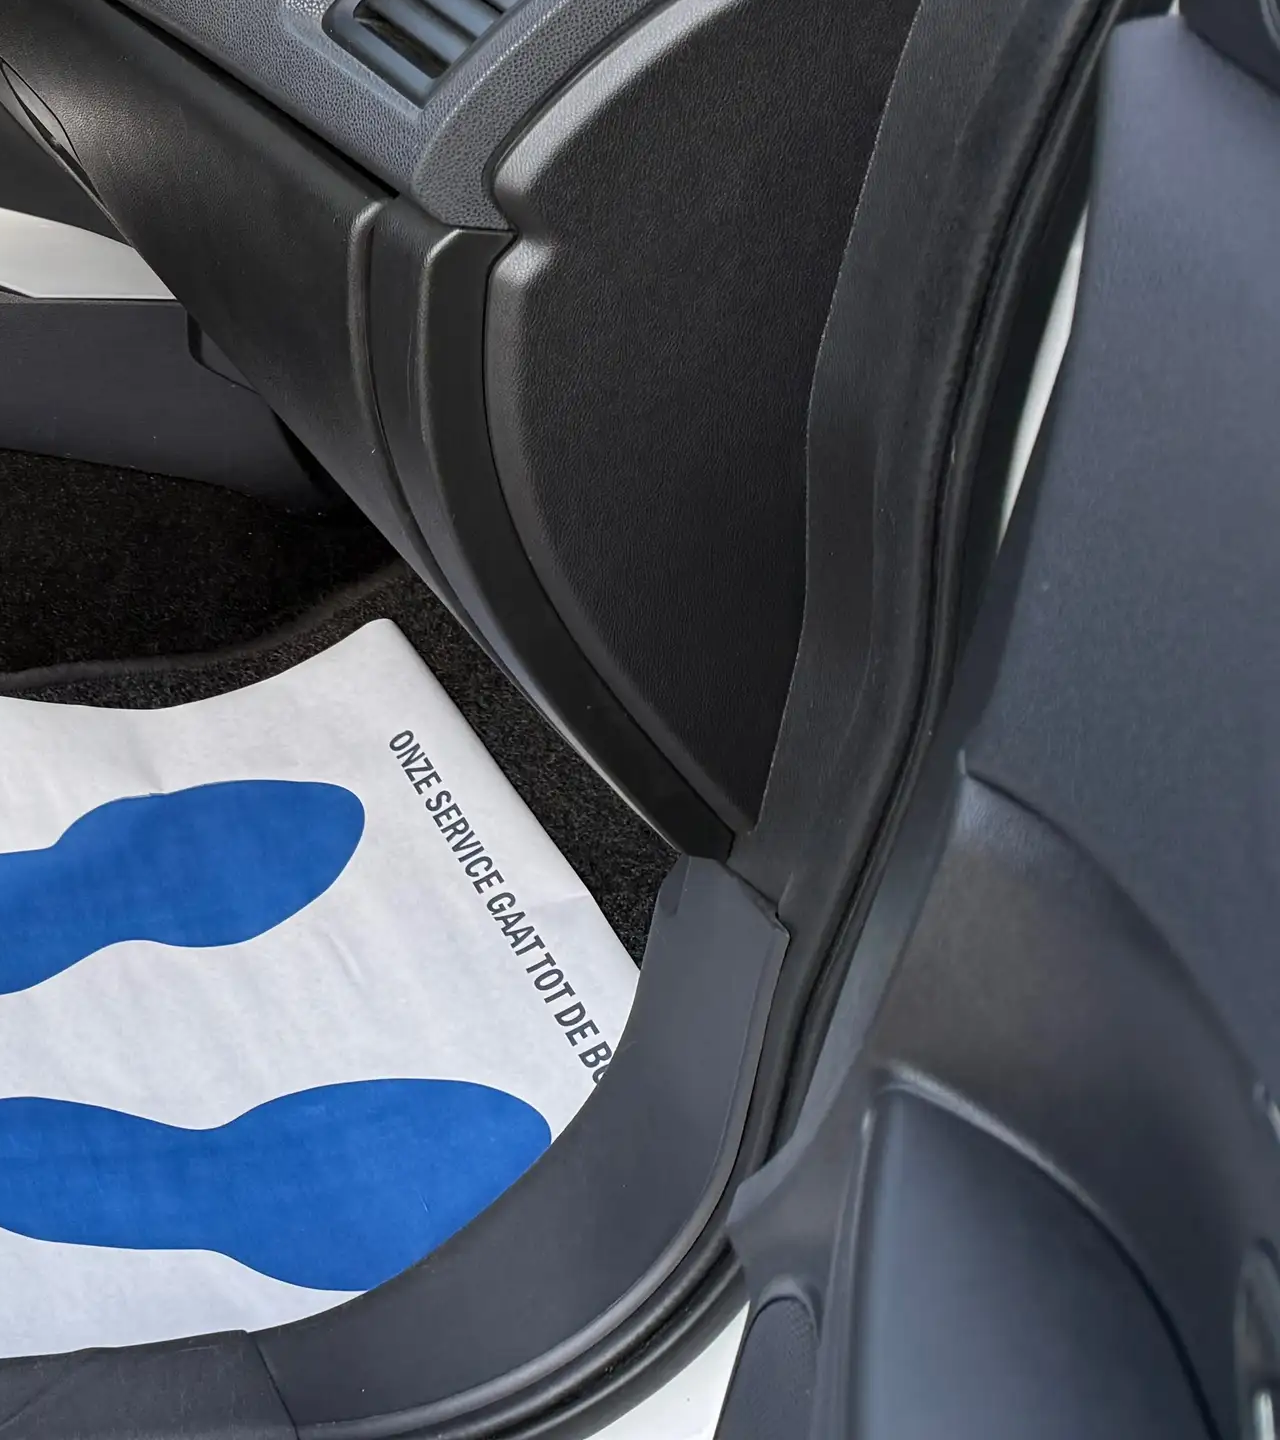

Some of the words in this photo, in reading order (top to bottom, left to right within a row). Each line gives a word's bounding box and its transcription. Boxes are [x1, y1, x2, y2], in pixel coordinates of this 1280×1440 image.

[389, 731, 443, 795] ONZE
[425, 790, 505, 895] SERVICE
[486, 892, 546, 957] GAAT
[525, 951, 576, 1004] TOT
[553, 1000, 600, 1047] DE
